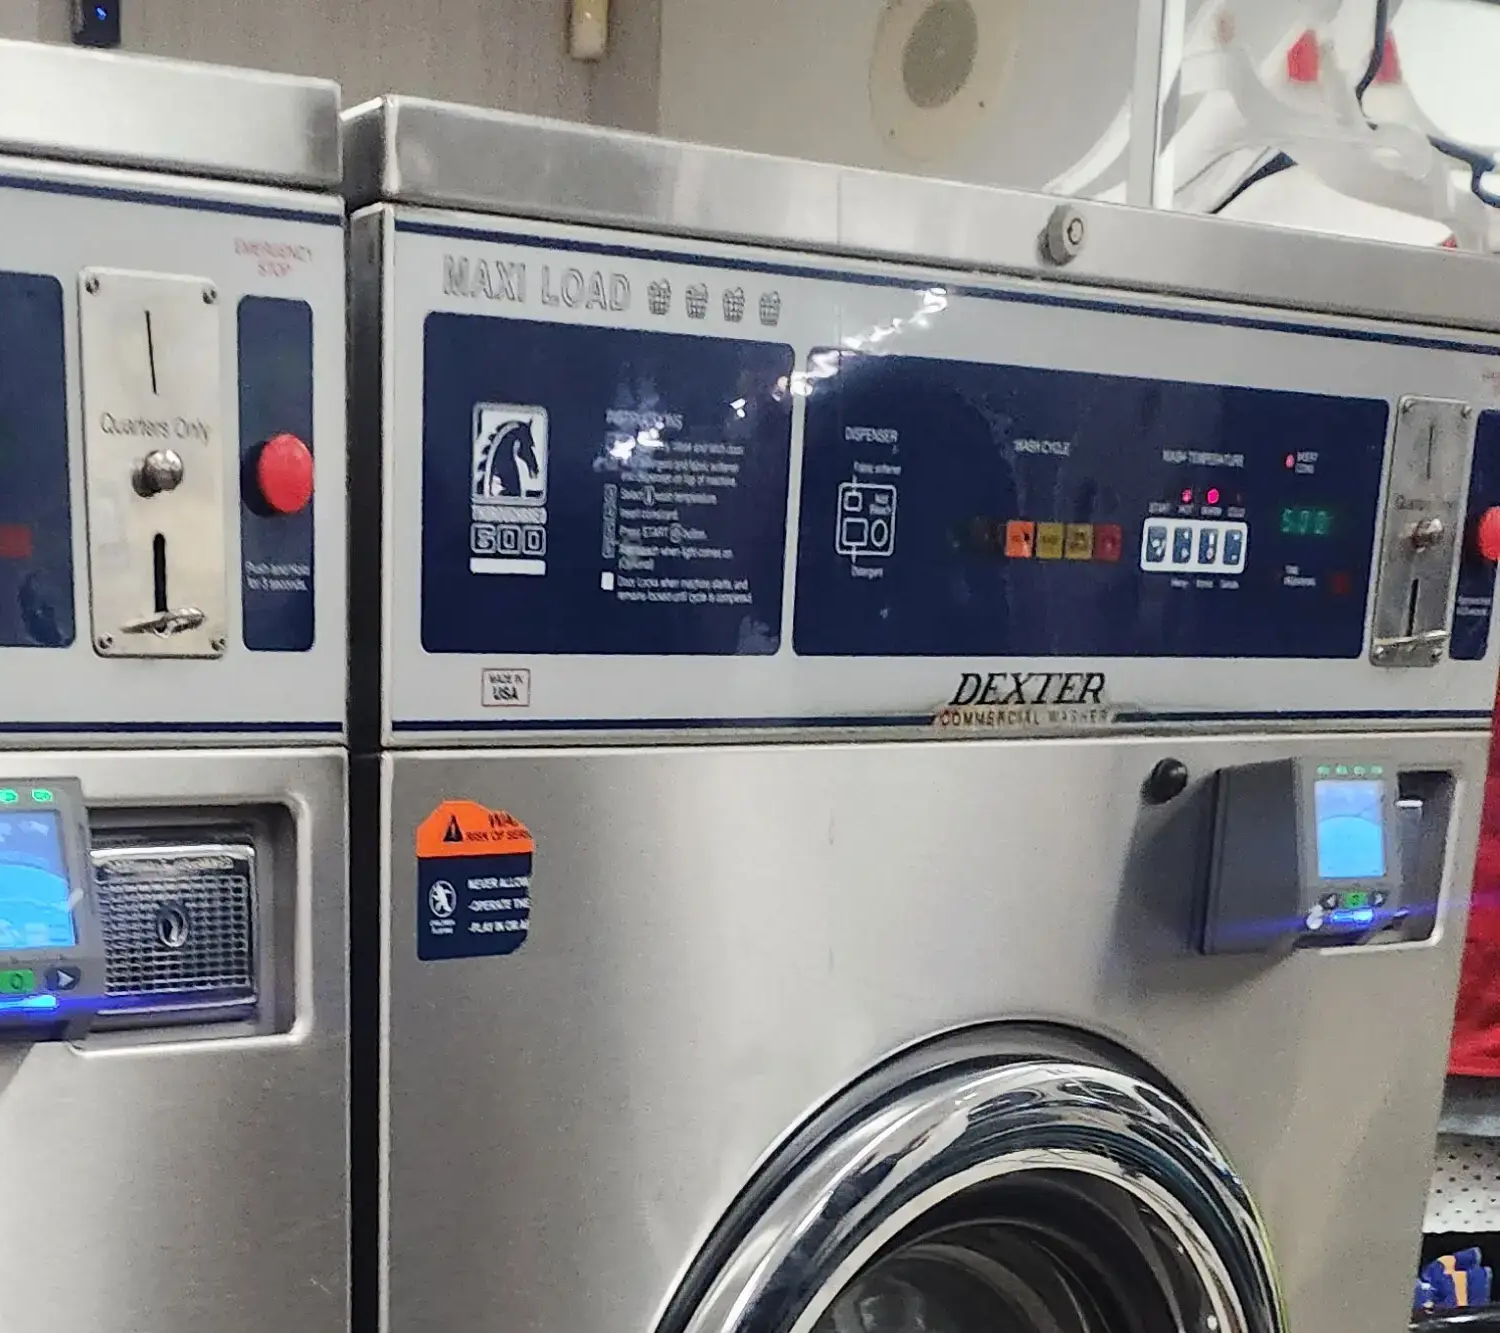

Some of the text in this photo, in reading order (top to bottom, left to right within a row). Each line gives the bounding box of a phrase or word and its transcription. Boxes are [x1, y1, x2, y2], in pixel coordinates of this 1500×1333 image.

[442, 254, 631, 312] MAXI LOAD
[100, 411, 212, 447] Quarters Only
[845, 426, 898, 442] DISPENSER
[948, 672, 1106, 706] DEXTER
[940, 709, 1109, 727] COMMERCIAL WASHER
